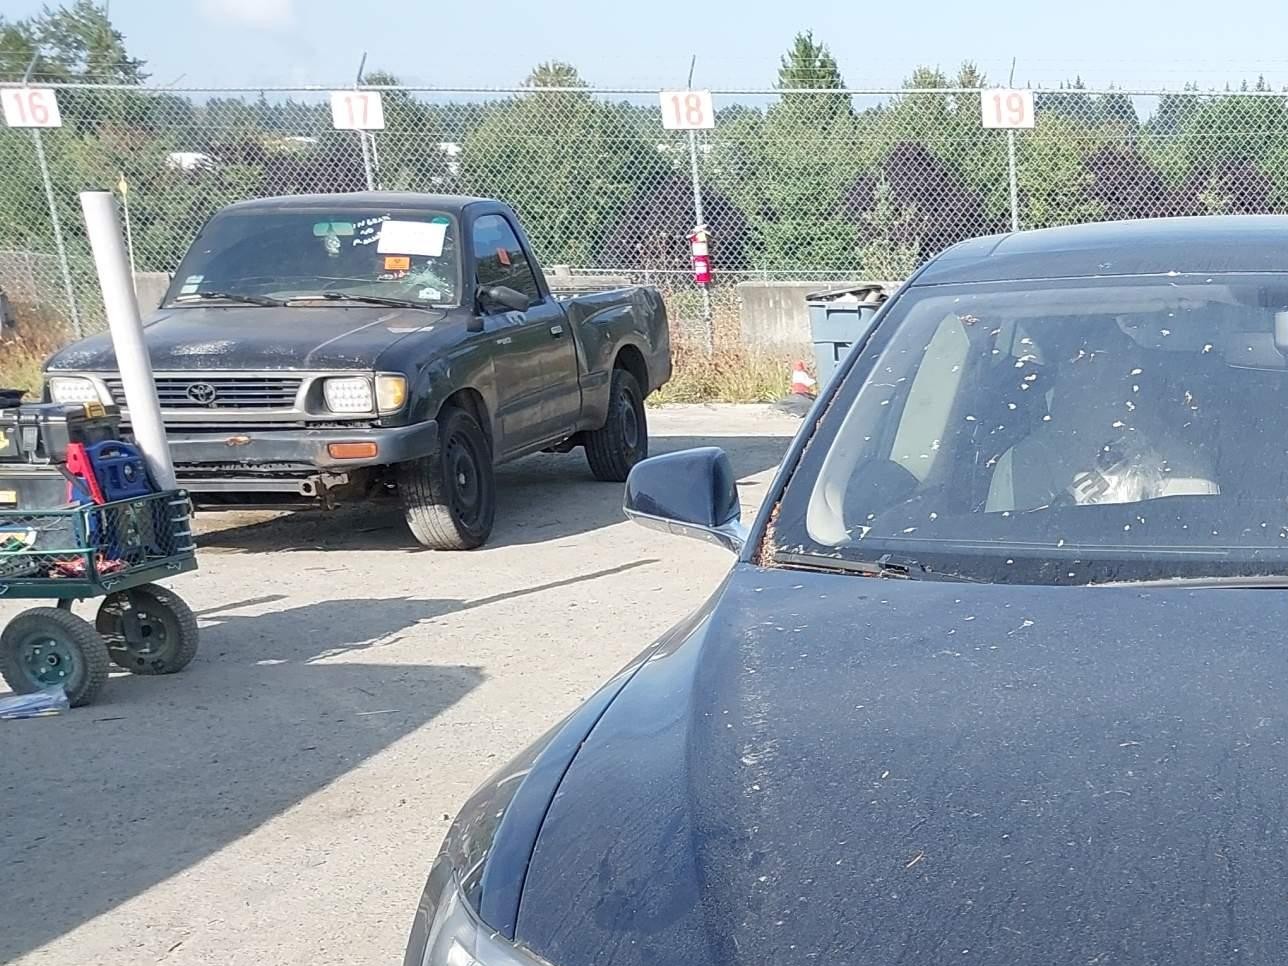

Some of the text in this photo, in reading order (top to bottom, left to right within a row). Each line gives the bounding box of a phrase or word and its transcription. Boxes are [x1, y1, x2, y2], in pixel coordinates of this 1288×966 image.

[14, 91, 49, 125] 16
[345, 94, 369, 125] 17
[672, 93, 704, 126] 18
[993, 92, 1025, 126] 19
